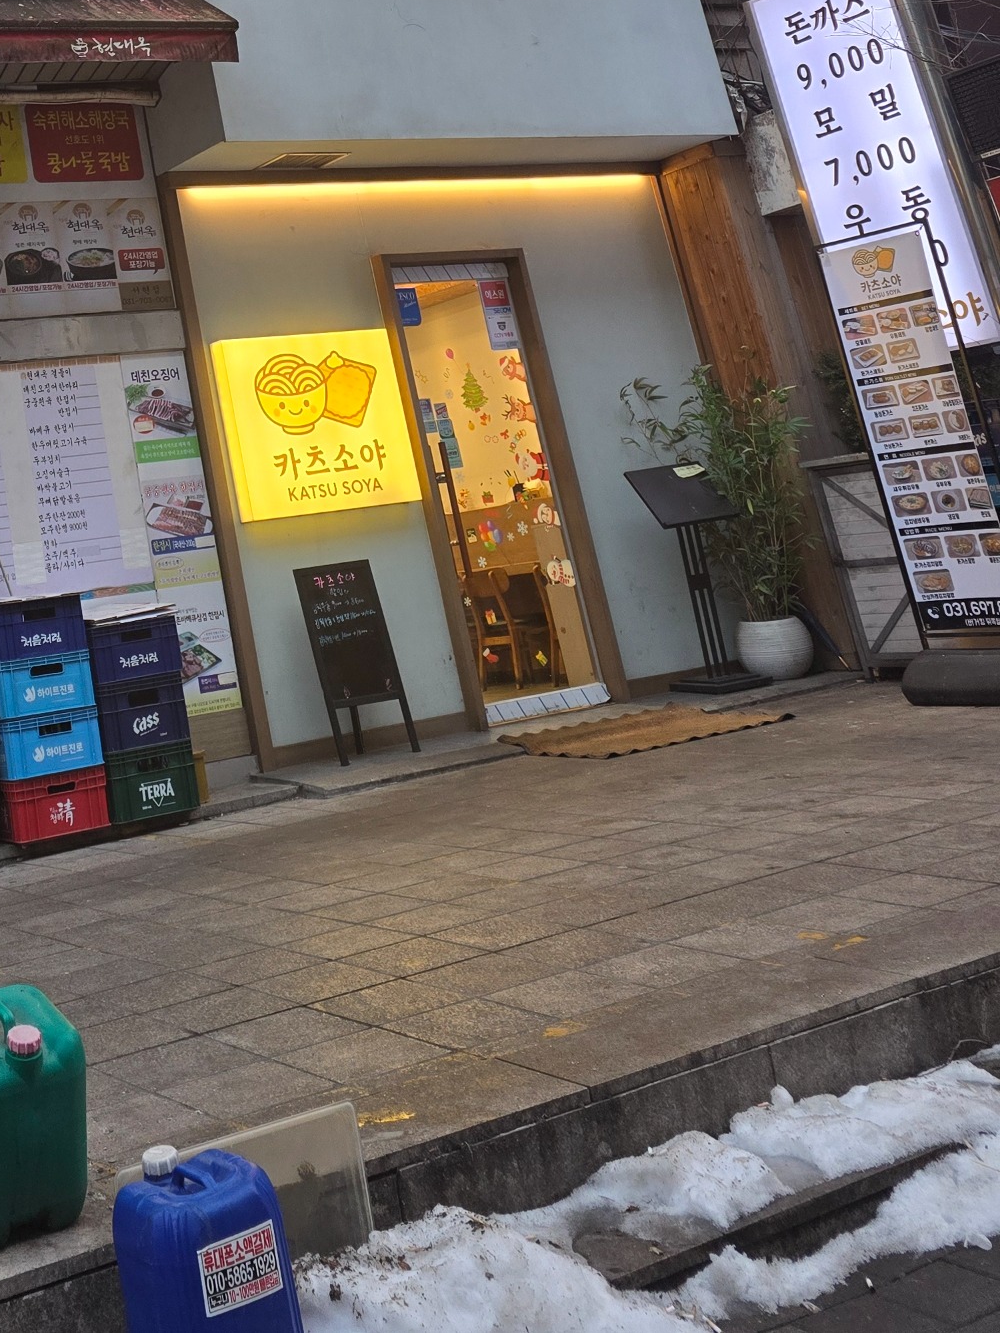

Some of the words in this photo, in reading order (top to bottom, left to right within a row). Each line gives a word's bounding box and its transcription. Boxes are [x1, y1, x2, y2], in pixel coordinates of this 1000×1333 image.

[92, 36, 152, 57] 현대옥
[796, 38, 884, 91] 9,000
[33, 110, 129, 130] 숙취해소해장국
[813, 83, 902, 140] 모밀
[64, 135, 90, 145] 선호도
[92, 134, 105, 144] 1위
[47, 151, 130, 175] 콩나물국밥
[823, 136, 916, 186] 7,000
[12, 220, 47, 234] 현대옥
[66, 218, 102, 232] 현대옥
[120, 224, 154, 239] 현대옥
[123, 251, 159, 260] 24시간영업
[860, 274, 902, 294] 카츠소야
[130, 367, 181, 384] 데친오징어
[273, 438, 387, 481] 카츠소야
[287, 480, 339, 502] KATSU
[342, 476, 384, 497] SOYA
[21, 632, 62, 647] 처음처럼
[119, 652, 159, 668] 처음처럼
[37, 683, 75, 698] 하이트진로
[46, 742, 84, 757] 하이트진로
[139, 779, 175, 802] TERRA
[203, 1228, 274, 1273] 휴대폰소액결제
